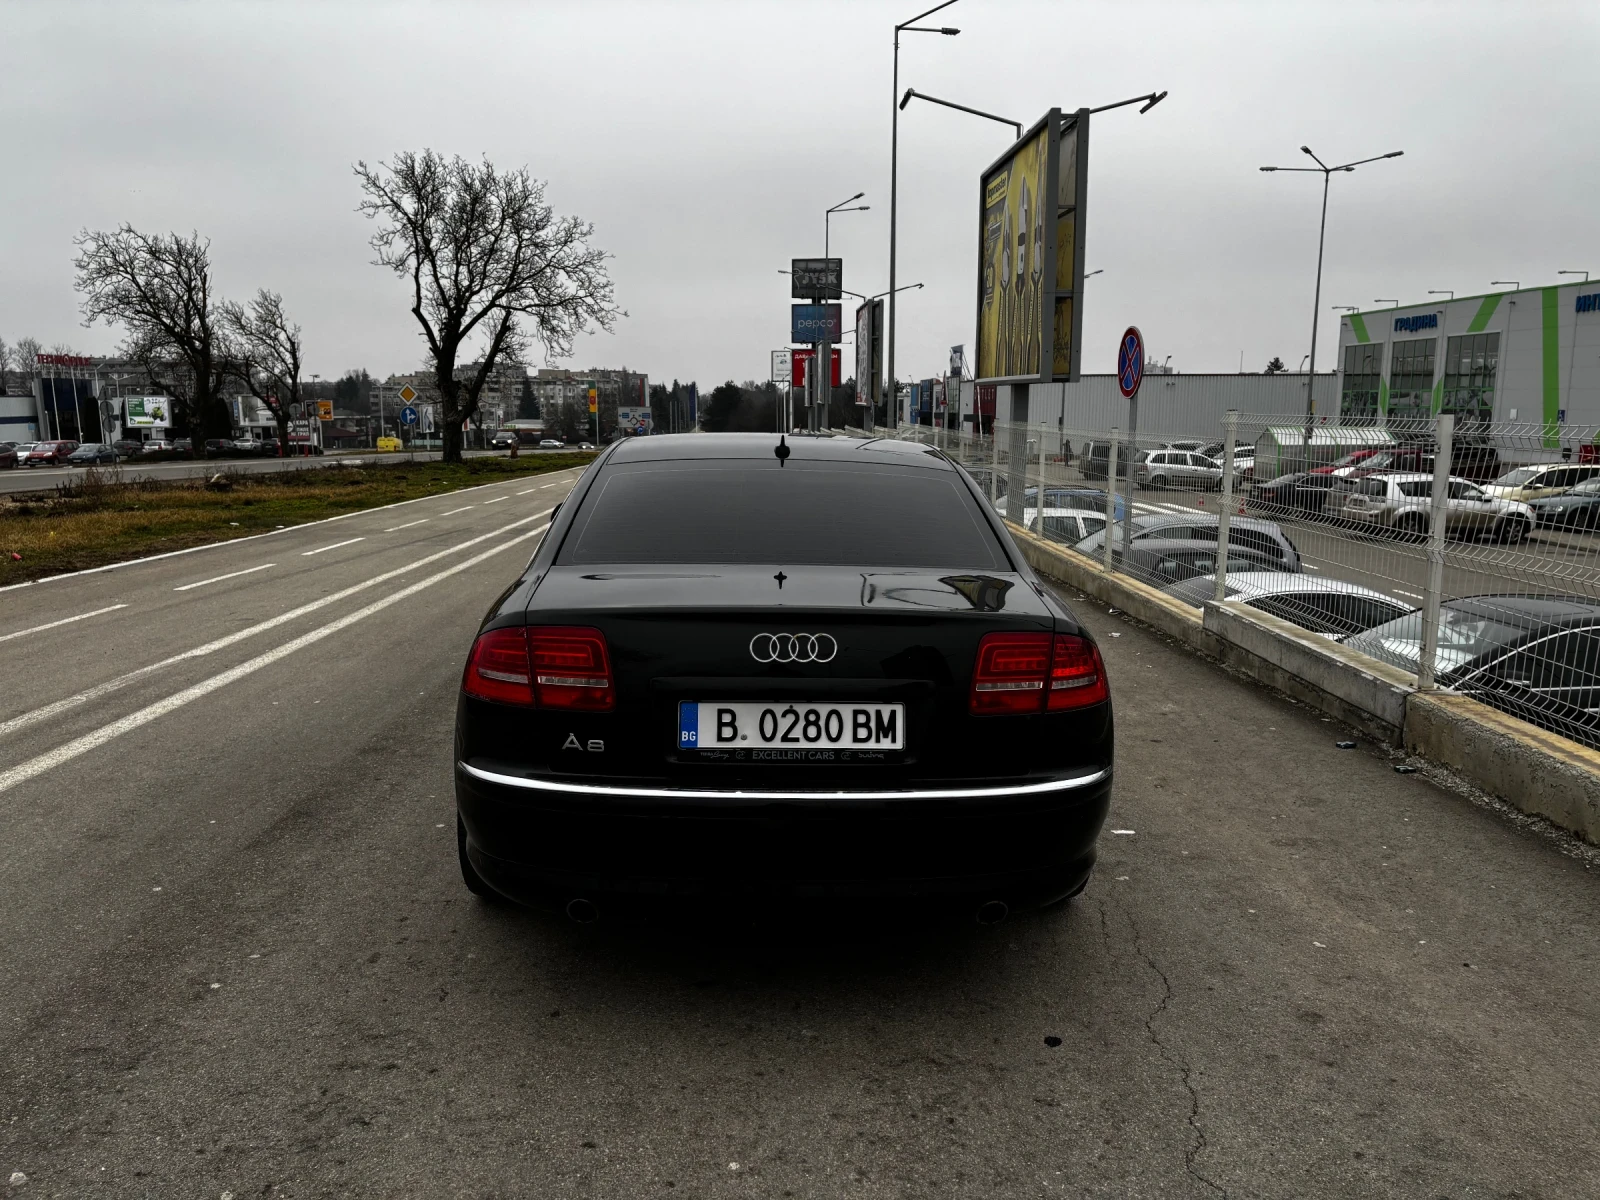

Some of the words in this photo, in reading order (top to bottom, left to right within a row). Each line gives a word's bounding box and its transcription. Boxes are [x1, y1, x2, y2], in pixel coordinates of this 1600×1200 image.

[802, 272, 838, 285] JYSK
[798, 319, 834, 329] pepco
[1394, 314, 1438, 332] ГРАДИНА
[716, 708, 739, 743] B
[758, 708, 844, 743] 0280
[852, 709, 897, 744] BM
[561, 734, 605, 752] A8
[682, 731, 696, 742] BG
[752, 751, 806, 760] EXCELLENT
[808, 751, 835, 760] CARS
